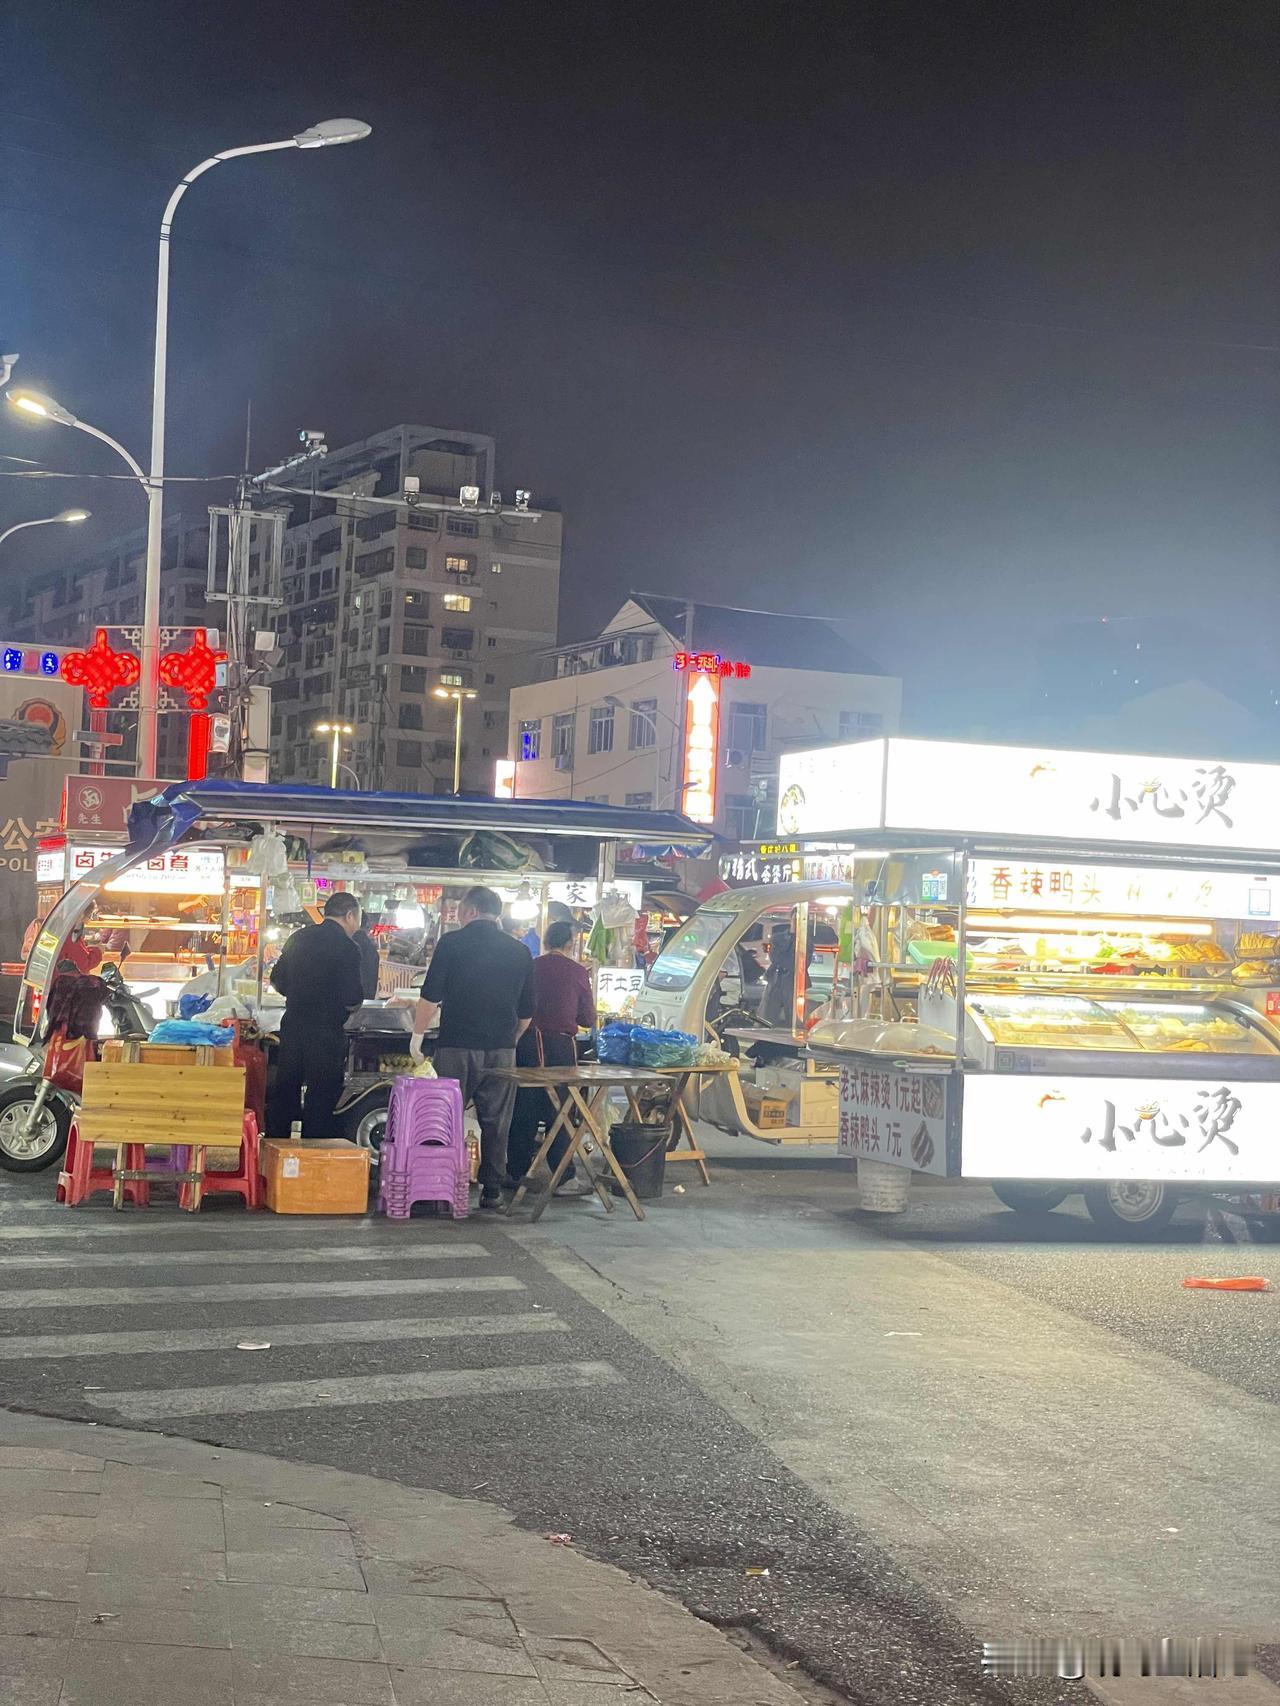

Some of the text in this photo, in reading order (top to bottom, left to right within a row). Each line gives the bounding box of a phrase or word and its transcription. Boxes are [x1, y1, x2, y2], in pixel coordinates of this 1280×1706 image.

[78, 813, 103, 825] 先生
[990, 866, 1102, 905] 香辣鸭头
[841, 1066, 891, 1111] 老式麻辣烫
[841, 1111, 902, 1158] 香辣鸭头 7元
